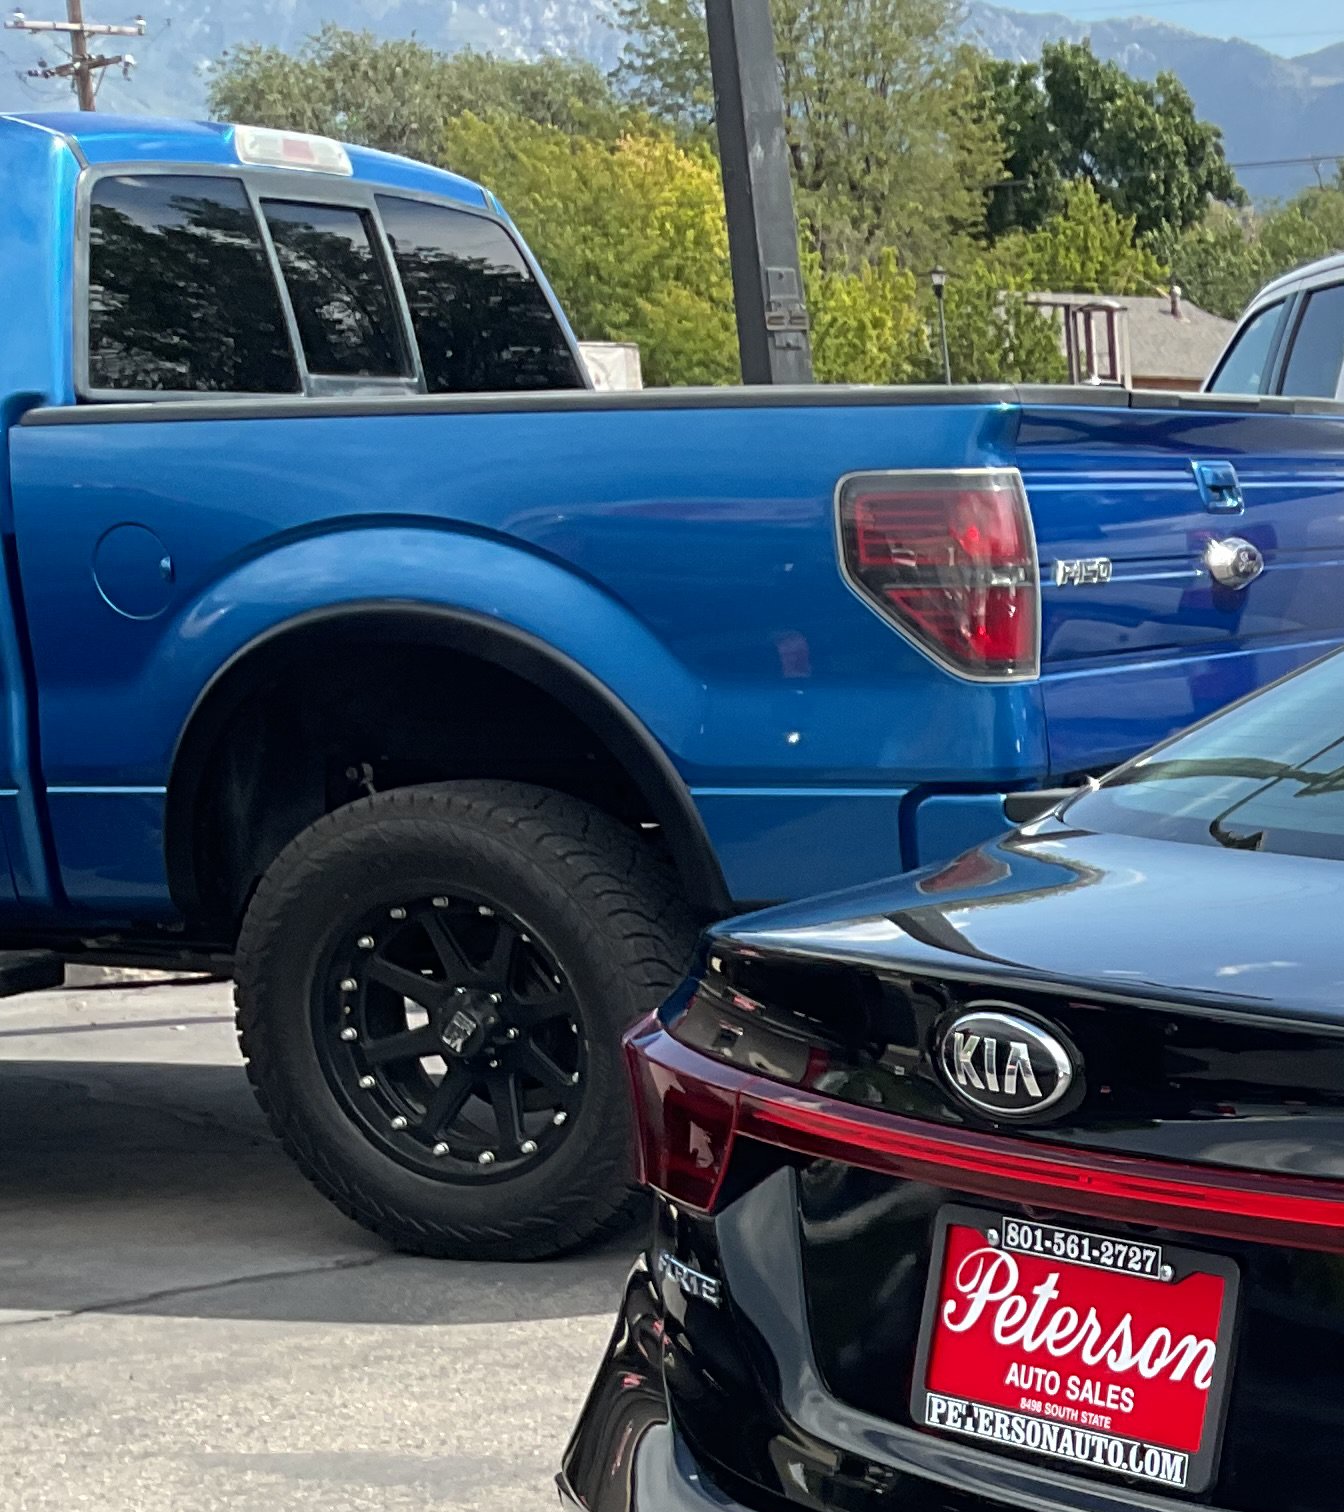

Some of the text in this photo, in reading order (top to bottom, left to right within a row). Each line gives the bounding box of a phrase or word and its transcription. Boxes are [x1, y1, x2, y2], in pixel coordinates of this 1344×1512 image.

[954, 1031, 1043, 1098] KIA
[1005, 1221, 1157, 1274] 801-561-2727
[943, 1247, 1217, 1390] Peterson
[1004, 1362, 1135, 1413] AUTO SALES
[1044, 1402, 1079, 1421] SOUTH
[1081, 1410, 1112, 1429] STATE
